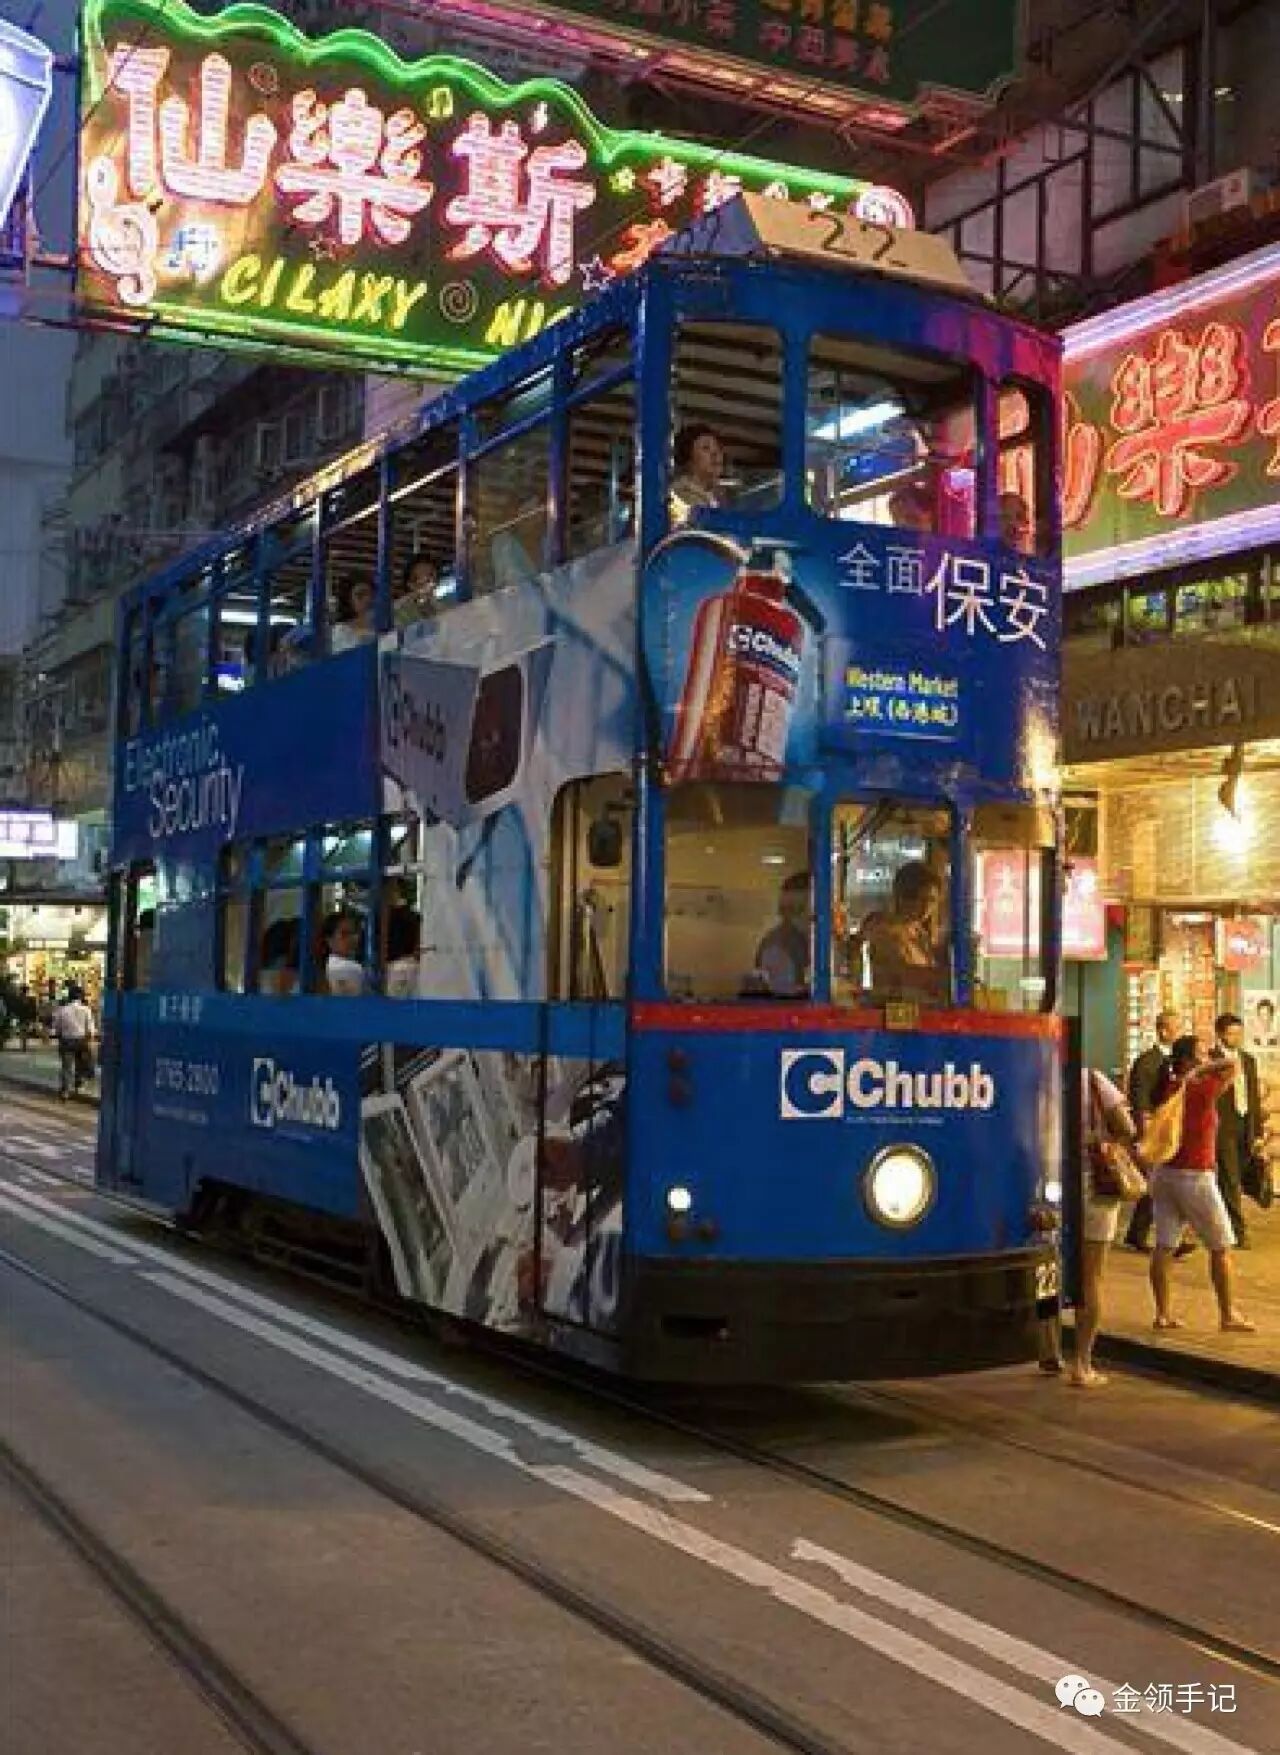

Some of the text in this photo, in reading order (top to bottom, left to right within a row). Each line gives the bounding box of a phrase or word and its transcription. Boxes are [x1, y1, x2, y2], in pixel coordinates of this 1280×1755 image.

[106, 42, 597, 288] 仙樂斯
[806, 211, 909, 268] 22
[149, 765, 244, 840] Security
[847, 1058, 995, 1109] Chubb
